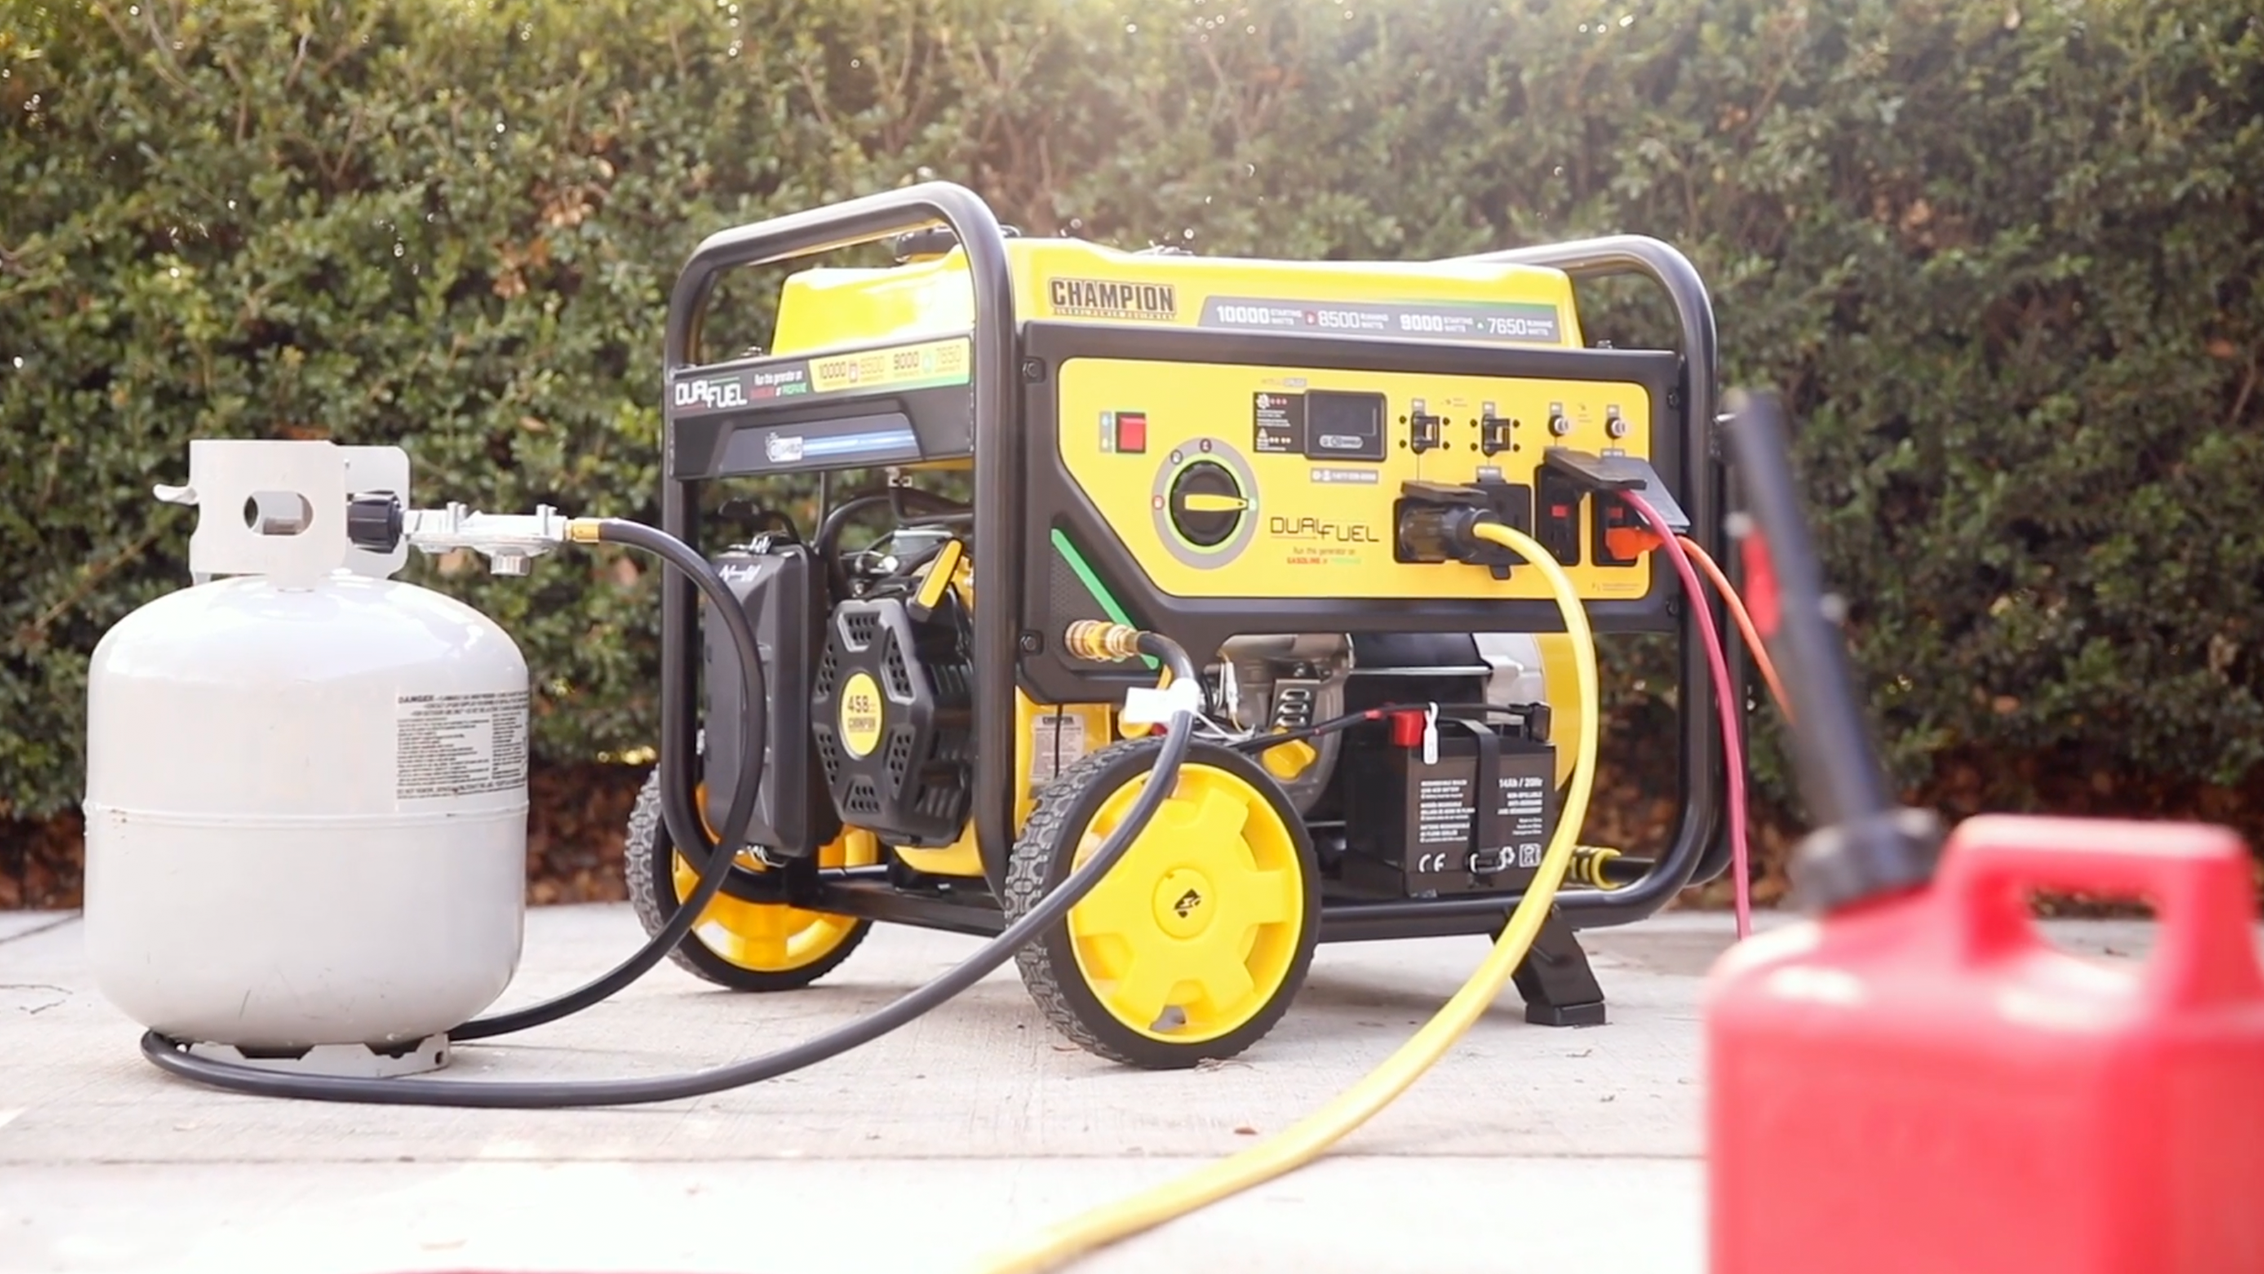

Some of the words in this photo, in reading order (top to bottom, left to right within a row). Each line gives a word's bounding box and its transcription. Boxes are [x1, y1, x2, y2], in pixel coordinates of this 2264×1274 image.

[1051, 280, 1174, 312] CHAMPION
[1216, 305, 1270, 325] 10000
[1318, 310, 1360, 328] 8500
[1400, 314, 1443, 332] 9000
[1486, 317, 1527, 336] 7650
[893, 351, 919, 370] 9000
[819, 361, 847, 380] 10000
[706, 382, 748, 408] FUEL
[1270, 517, 1324, 534] DUAL
[1321, 525, 1380, 542] FUEL
[847, 695, 869, 713] 458
[1499, 778, 1518, 789] 14Ah
[1419, 853, 1446, 872] CE
